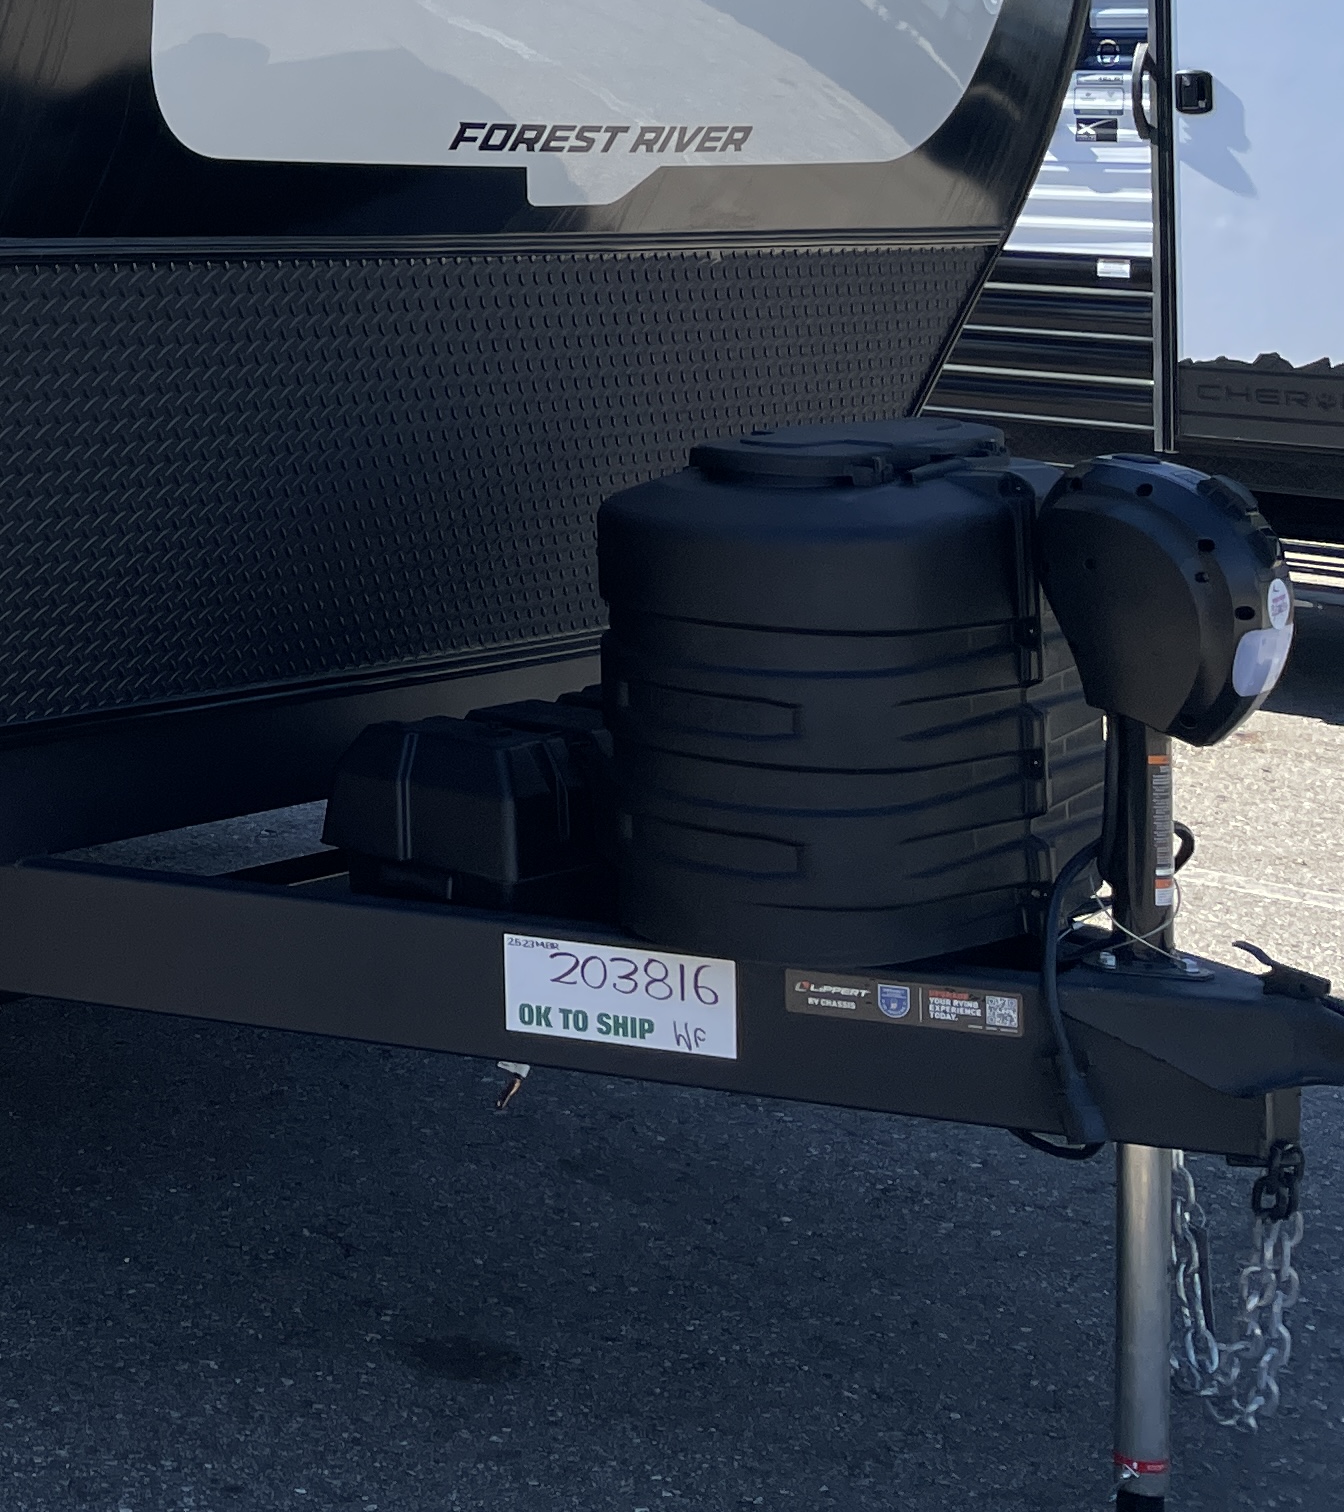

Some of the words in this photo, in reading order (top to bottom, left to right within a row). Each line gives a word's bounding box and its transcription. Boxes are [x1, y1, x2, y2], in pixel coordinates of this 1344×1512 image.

[448, 121, 631, 153] FOREST
[629, 125, 754, 154] RIVER
[549, 951, 719, 1005] 203816
[807, 996, 819, 1006] RV
[820, 998, 856, 1010] CHASSIS
[928, 997, 952, 1007] YOUR
[929, 1004, 982, 1017] EXPERIENCE
[518, 1002, 554, 1028] OK
[559, 1006, 589, 1032] TO
[596, 1012, 655, 1040] SHIP
